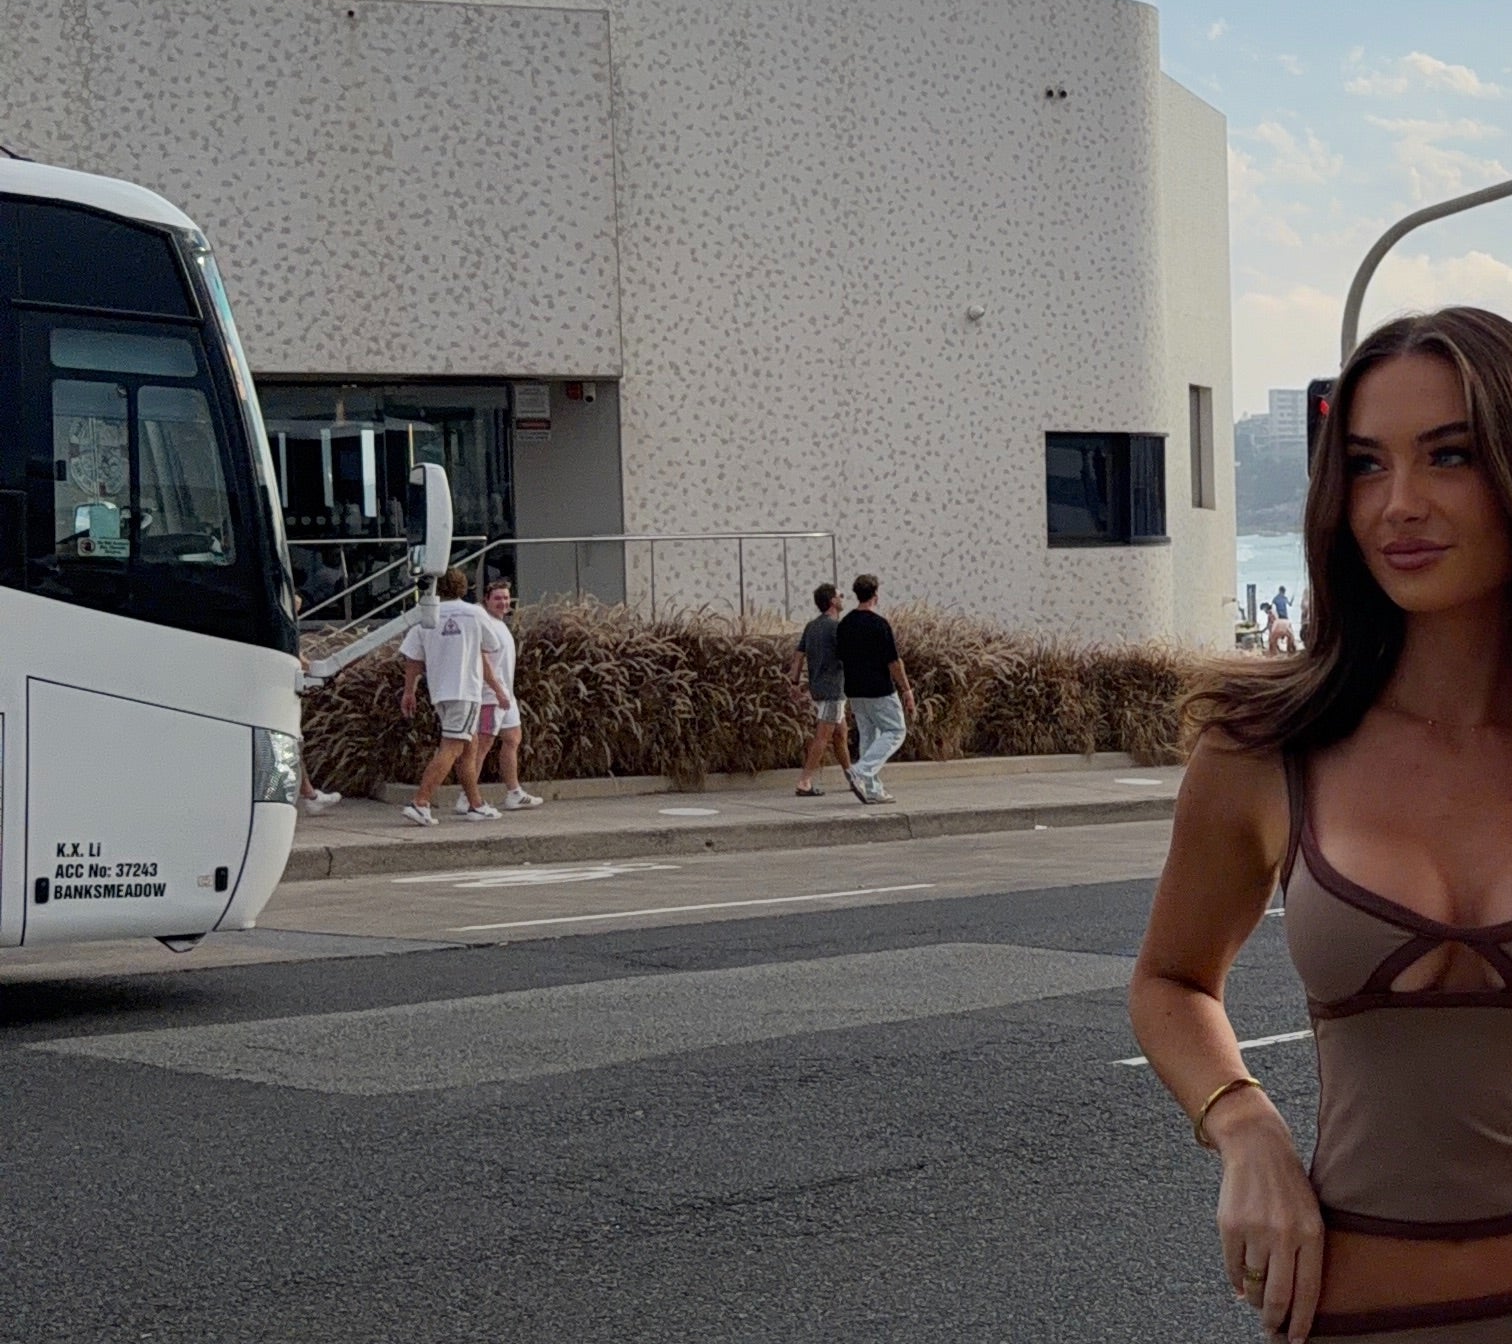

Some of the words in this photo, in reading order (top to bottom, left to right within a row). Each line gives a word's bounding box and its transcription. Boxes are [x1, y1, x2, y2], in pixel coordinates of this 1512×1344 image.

[56, 842, 84, 858] K.X.
[54, 863, 84, 879] ACC
[88, 863, 111, 878] No:
[115, 862, 158, 877] 37243
[53, 882, 166, 900] BANKSMEADOW
